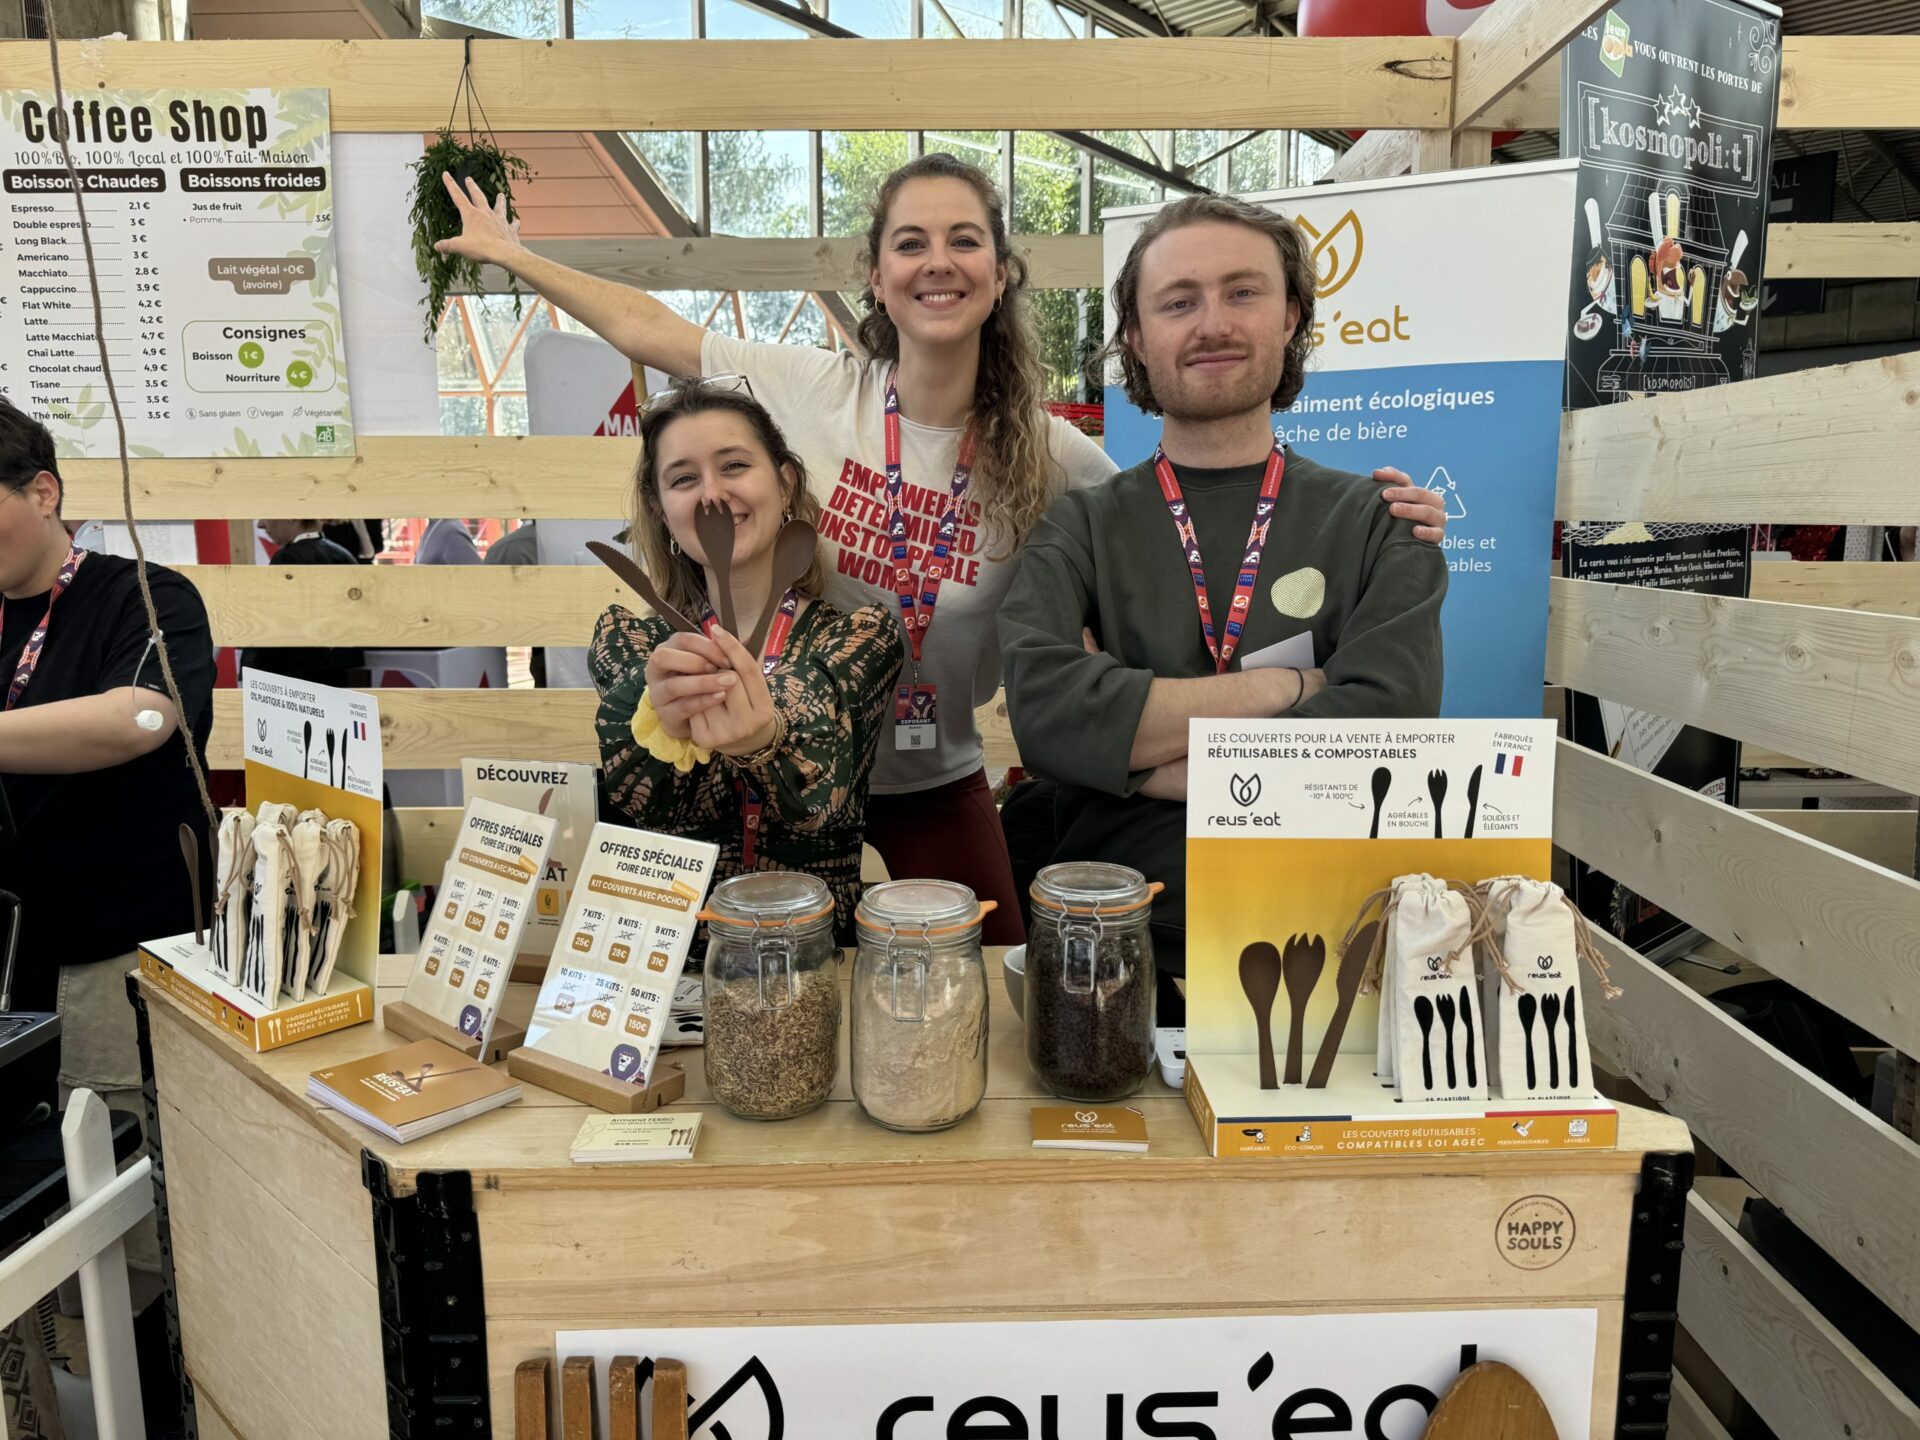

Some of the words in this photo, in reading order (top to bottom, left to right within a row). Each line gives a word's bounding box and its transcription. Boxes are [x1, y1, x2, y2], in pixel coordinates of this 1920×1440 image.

[1634, 40, 1657, 60] VOUS
[1658, 50, 1699, 74] OUVRENT
[1701, 64, 1715, 80] LES
[1717, 69, 1748, 90] PORTES
[1751, 82, 1762, 94] DE
[22, 99, 153, 143] Coffee
[168, 100, 268, 148] Shop
[52, 150, 82, 166] Bo,
[86, 150, 124, 166] 100%
[128, 150, 166, 167] Local
[170, 152, 182, 164] et
[86, 174, 159, 189] Chaudes
[188, 174, 261, 188] Boissons
[264, 173, 321, 188] froides
[12, 204, 54, 213] Espresso
[129, 202, 140, 210] 2,1
[190, 216, 223, 224] Pomme
[15, 238, 38, 246] Long
[41, 237, 67, 245] Black
[134, 251, 139, 259] 3
[19, 269, 68, 277] Macchiato
[135, 268, 149, 276] 2,8
[217, 265, 236, 274] Lait
[239, 264, 280, 276] végétal
[20, 286, 77, 294] Cappuccino
[137, 284, 150, 292] 3,9
[243, 280, 282, 290] (avoine)
[138, 300, 152, 308] 4,2
[140, 316, 154, 324] 4,2
[141, 332, 156, 340] 4,7
[222, 325, 306, 342] Consignes
[28, 349, 49, 357] Chaï
[143, 348, 157, 356] 4,9
[192, 352, 233, 360] Boisson
[29, 365, 70, 373] Chocolat
[73, 365, 101, 373] chaud
[144, 364, 158, 372] 4,9
[226, 374, 280, 382] Nourriture
[30, 381, 60, 389] Tisane
[145, 380, 159, 388] 3,5
[32, 396, 49, 404] Thé
[147, 396, 160, 404] 3,5
[1369, 388, 1495, 411] écologiques
[34, 412, 50, 420] Thé
[53, 412, 71, 420] noir
[220, 410, 241, 418] gluten
[260, 410, 283, 418] Vegan
[1274, 424, 1320, 444] êche
[1326, 424, 1351, 441] de
[1358, 420, 1408, 439] bière
[1479, 536, 1496, 550] et
[259, 680, 283, 695] COUVERTS
[289, 689, 316, 703] EMPORTER
[258, 694, 281, 708] PLASTIQUE
[286, 701, 299, 712] 100%
[299, 704, 325, 718] NATURELS
[1208, 733, 1226, 743] LES
[1230, 733, 1291, 744] COUVERTS
[1295, 734, 1326, 743] POUR
[1330, 734, 1343, 743] LA
[1346, 734, 1381, 743] VENTE
[1385, 731, 1392, 743] À
[1396, 734, 1455, 744] EMPORTER
[1494, 732, 1533, 744] FABRIQUÉS
[1208, 746, 1298, 758] RÉUTILISABLES
[1301, 748, 1311, 758] &
[1315, 748, 1417, 759] COMPOSTABLES
[1504, 742, 1532, 751] FRANCE
[477, 764, 568, 784] DÉCOUVREZ
[1208, 812, 1281, 826] reus'eat
[1484, 822, 1518, 830] ÉLÉGANTS
[470, 817, 499, 835] OFFRES
[500, 825, 543, 848] SPÉCIALES
[480, 836, 496, 848] FOIRE
[497, 842, 504, 851] DE
[505, 844, 522, 856] LYON
[600, 841, 639, 860] OFFRES
[642, 849, 704, 872] SPÉCIALES
[461, 851, 469, 859] KIT
[469, 853, 493, 869] COUVERTS
[493, 861, 506, 873] AVEC
[506, 864, 530, 880] POCHON
[616, 861, 639, 874] FOIRE
[640, 866, 651, 876] DE
[652, 868, 675, 881] LYON
[591, 878, 602, 887] KIT
[602, 882, 637, 897] COUVERTS
[637, 889, 656, 901] AVEC
[657, 894, 688, 907] POCHON
[1528, 972, 1562, 980] reus'eat
[1343, 1130, 1358, 1139] LES
[1360, 1129, 1410, 1138] COUVERTS
[1412, 1126, 1476, 1137] RÉUTILISABLES
[1337, 1140, 1423, 1150] COMPATIBLES
[1428, 1140, 1447, 1148] LOI
[1453, 1138, 1486, 1147] AGEC
[1507, 1220, 1564, 1236] HAPPY
[1506, 1236, 1562, 1250] SOULS
